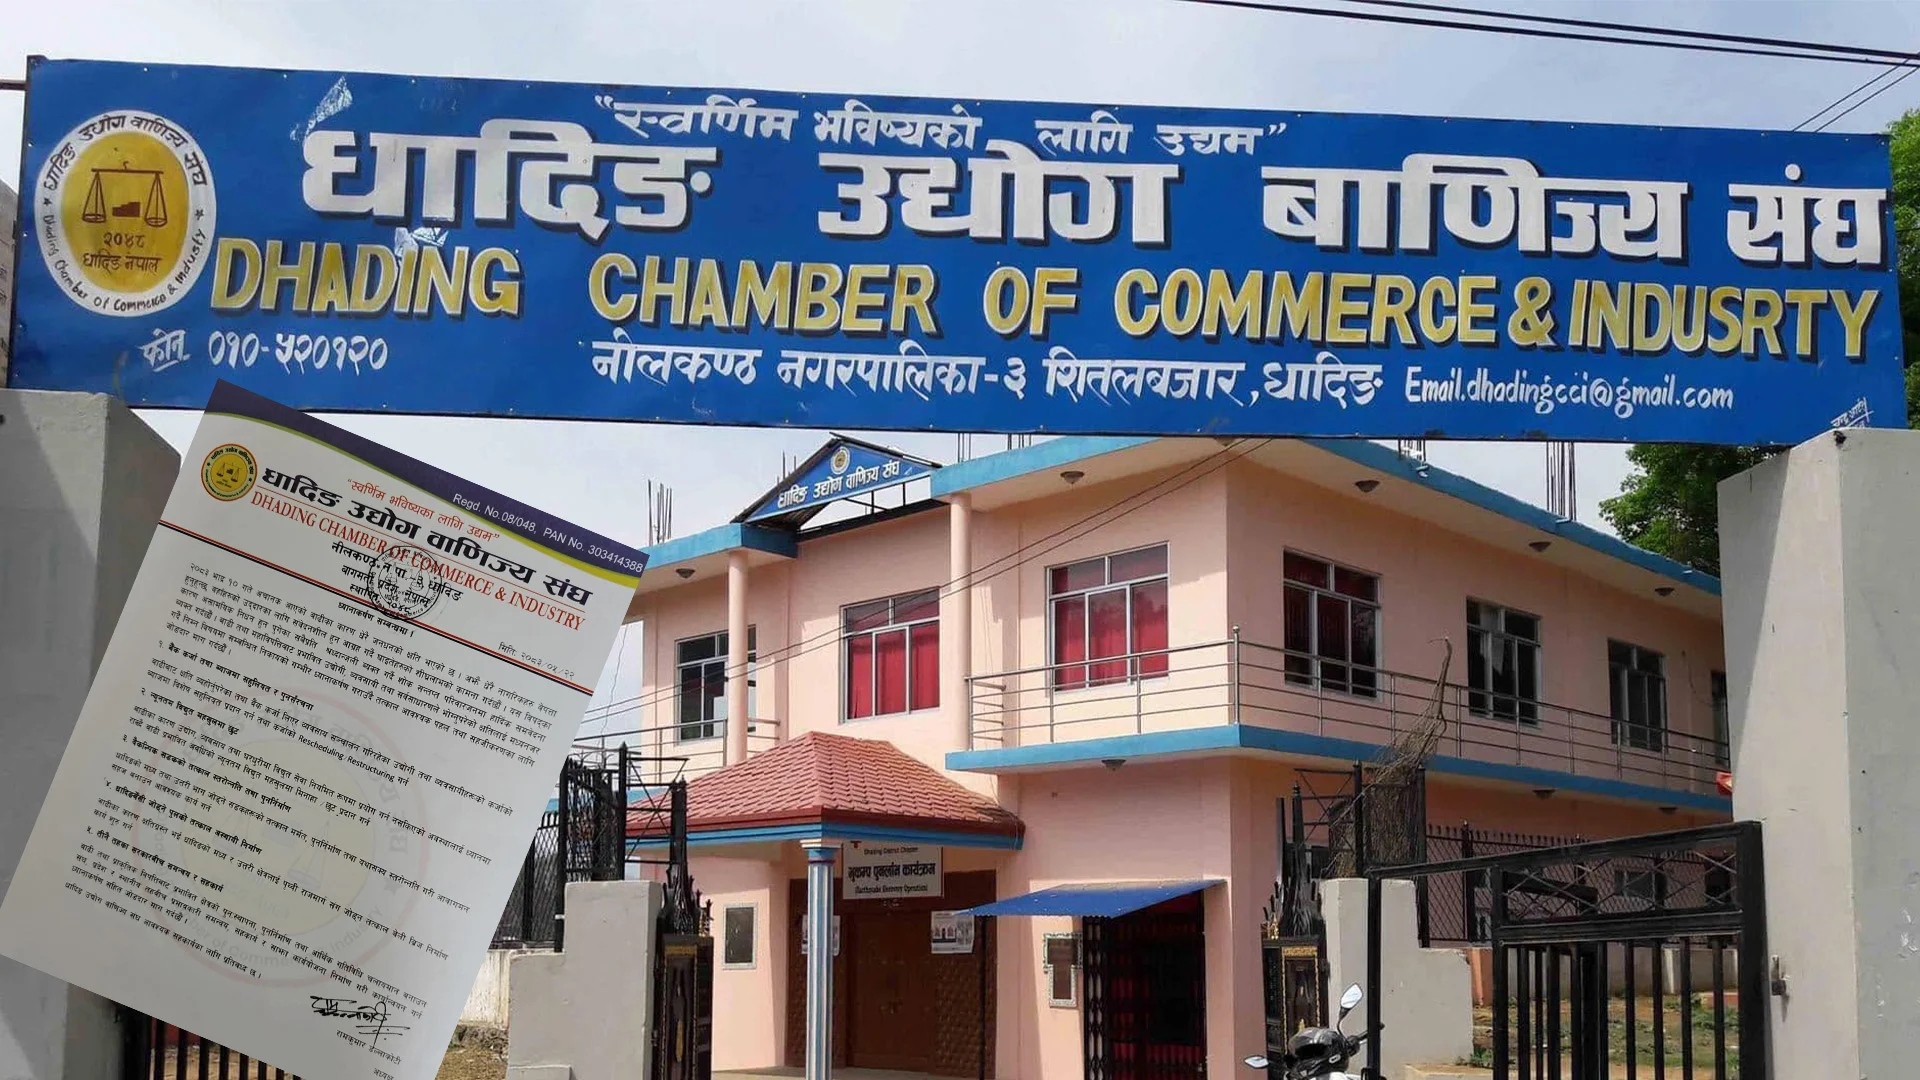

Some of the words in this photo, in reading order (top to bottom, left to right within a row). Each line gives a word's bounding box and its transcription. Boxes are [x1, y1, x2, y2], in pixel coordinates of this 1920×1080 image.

[595, 93, 799, 140] “स्वर्णिम
[813, 98, 983, 150] भविष्यको
[1034, 109, 1134, 156] लागि
[302, 118, 718, 242] धादिङ
[1260, 152, 1690, 262] बाणिज्य
[1727, 163, 1889, 266] संघ
[208, 236, 523, 318] DHADING
[588, 252, 940, 338] CHAMBER
[982, 264, 1079, 336] OF
[1113, 266, 1498, 347] COMMERCE
[1507, 276, 1560, 348] &
[1567, 278, 1881, 360] INDUSRTY
[591, 327, 763, 387] नीलकण्ठ
[882, 459, 901, 479] संघ
[250, 489, 320, 528] DHADING
[315, 515, 390, 555] CHAMBER
[386, 542, 411, 564] OF
[407, 551, 494, 596] COMMERCE
[492, 584, 509, 602] &
[507, 590, 586, 632] INDUSTRY
[261, 467, 342, 507] धादिङ
[347, 500, 421, 539] उद्योग
[426, 530, 536, 583] वाणिज्य
[542, 574, 593, 611] संघ
[437, 514, 463, 529] लागि
[452, 493, 480, 510] Regd.
[542, 527, 566, 543] PAN
[567, 536, 583, 551] No.
[587, 544, 642, 572] 303414388
